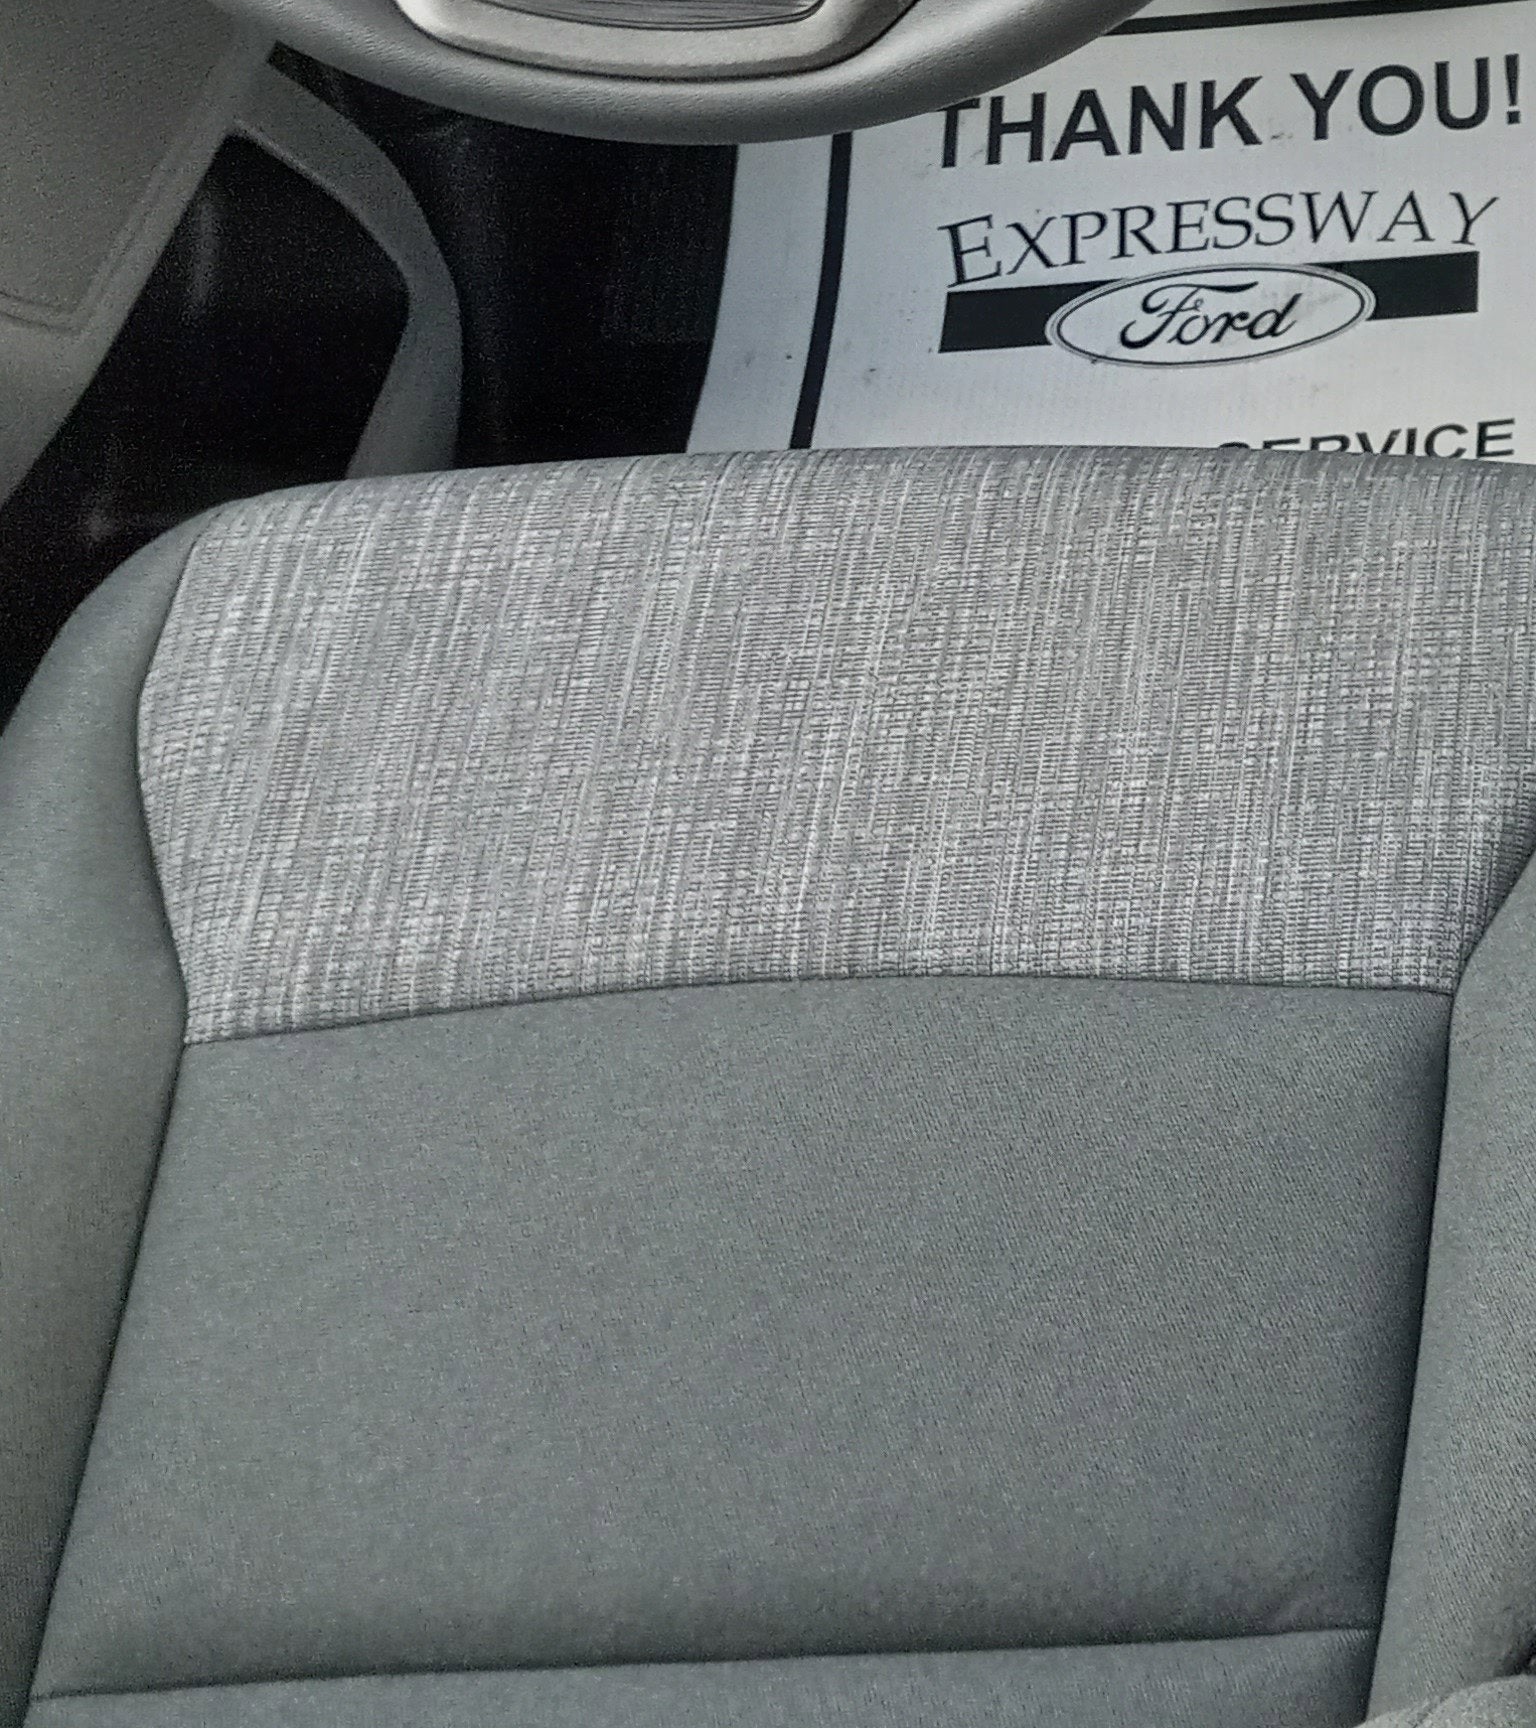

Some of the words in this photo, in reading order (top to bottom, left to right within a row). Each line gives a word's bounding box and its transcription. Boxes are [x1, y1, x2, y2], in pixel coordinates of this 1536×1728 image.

[937, 76, 1263, 169] THANK
[1290, 53, 1522, 141] YOU!
[936, 190, 1500, 289] EXPRESSWAY
[1119, 280, 1303, 352] Ford
[1218, 418, 1515, 458] VICE
